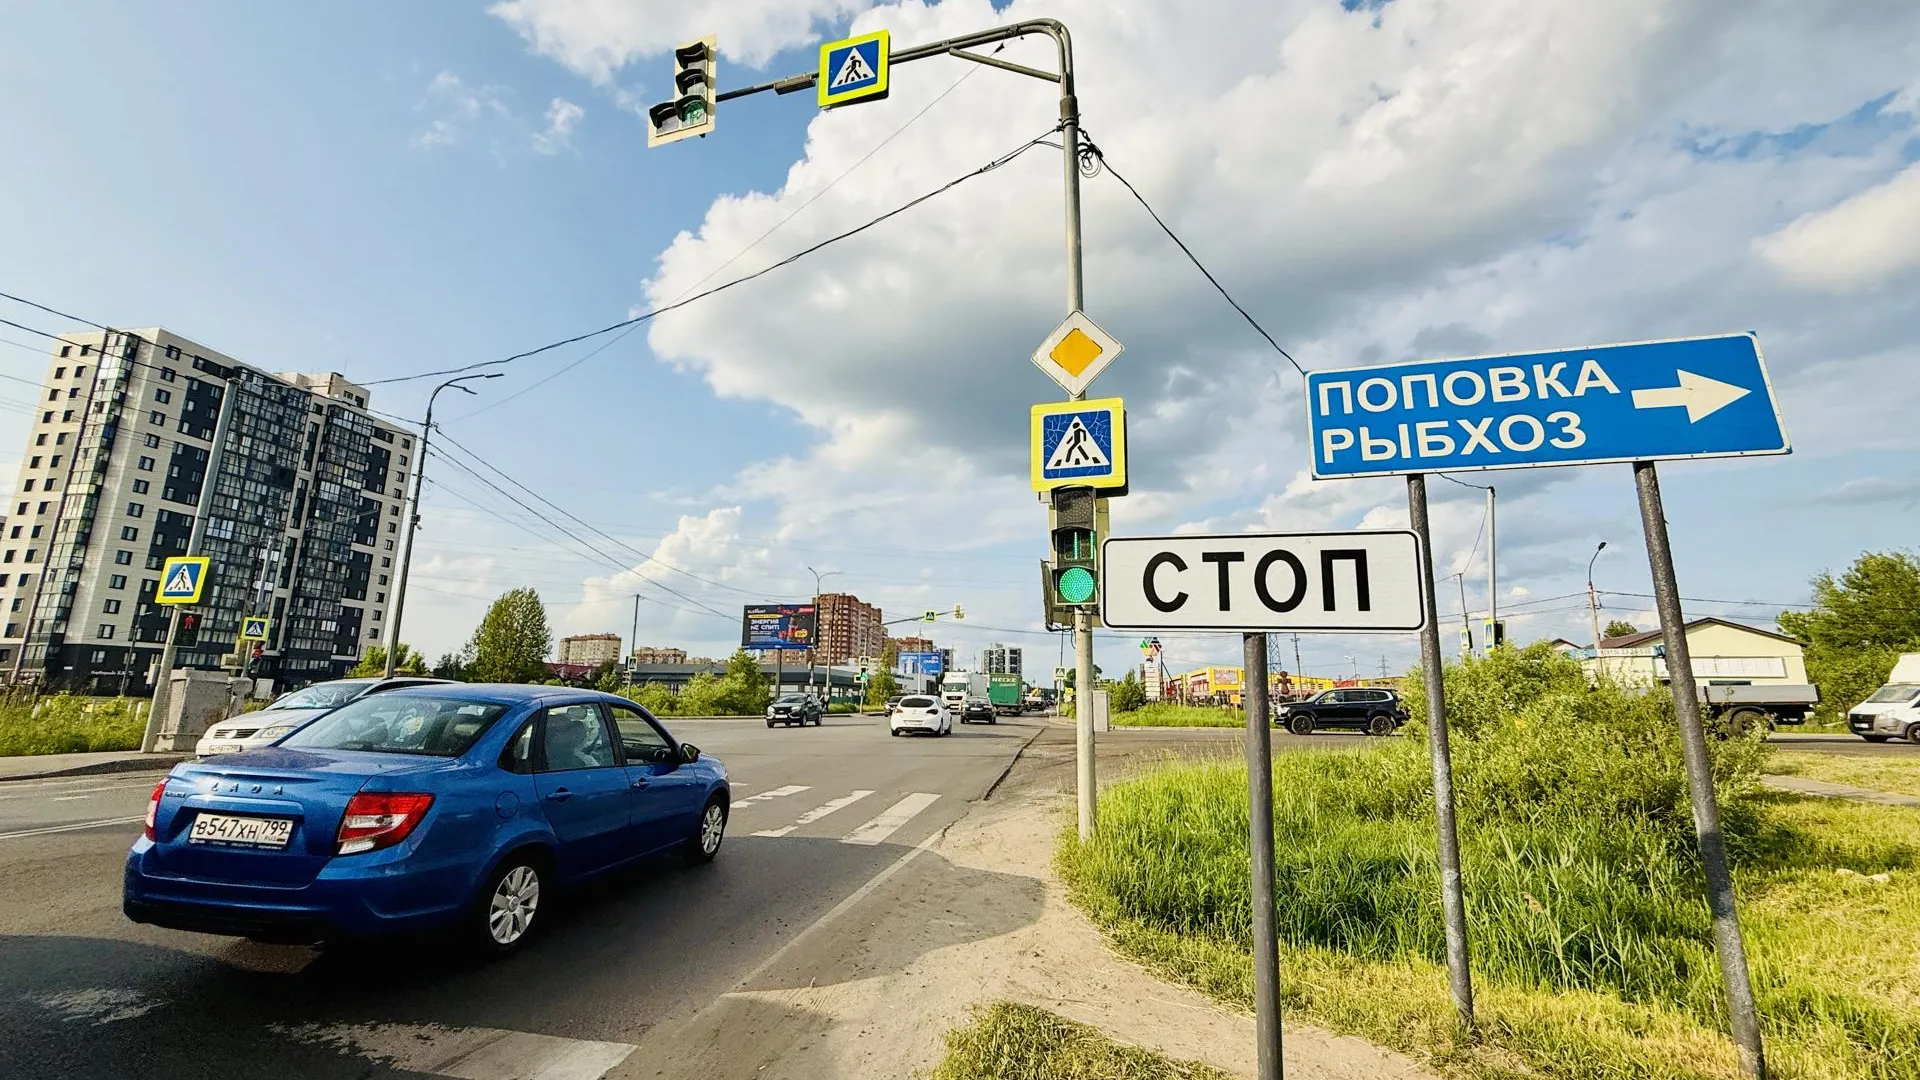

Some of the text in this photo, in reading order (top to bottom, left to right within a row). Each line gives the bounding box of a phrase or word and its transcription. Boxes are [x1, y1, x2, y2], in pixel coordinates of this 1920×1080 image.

[1318, 359, 1621, 416] ПОПОВКА
[1322, 411, 1587, 464] РЫБХОЗ
[1142, 549, 1371, 613] СТОП
[211, 782, 283, 796] LADA
[196, 818, 289, 839] В547ХН 799
